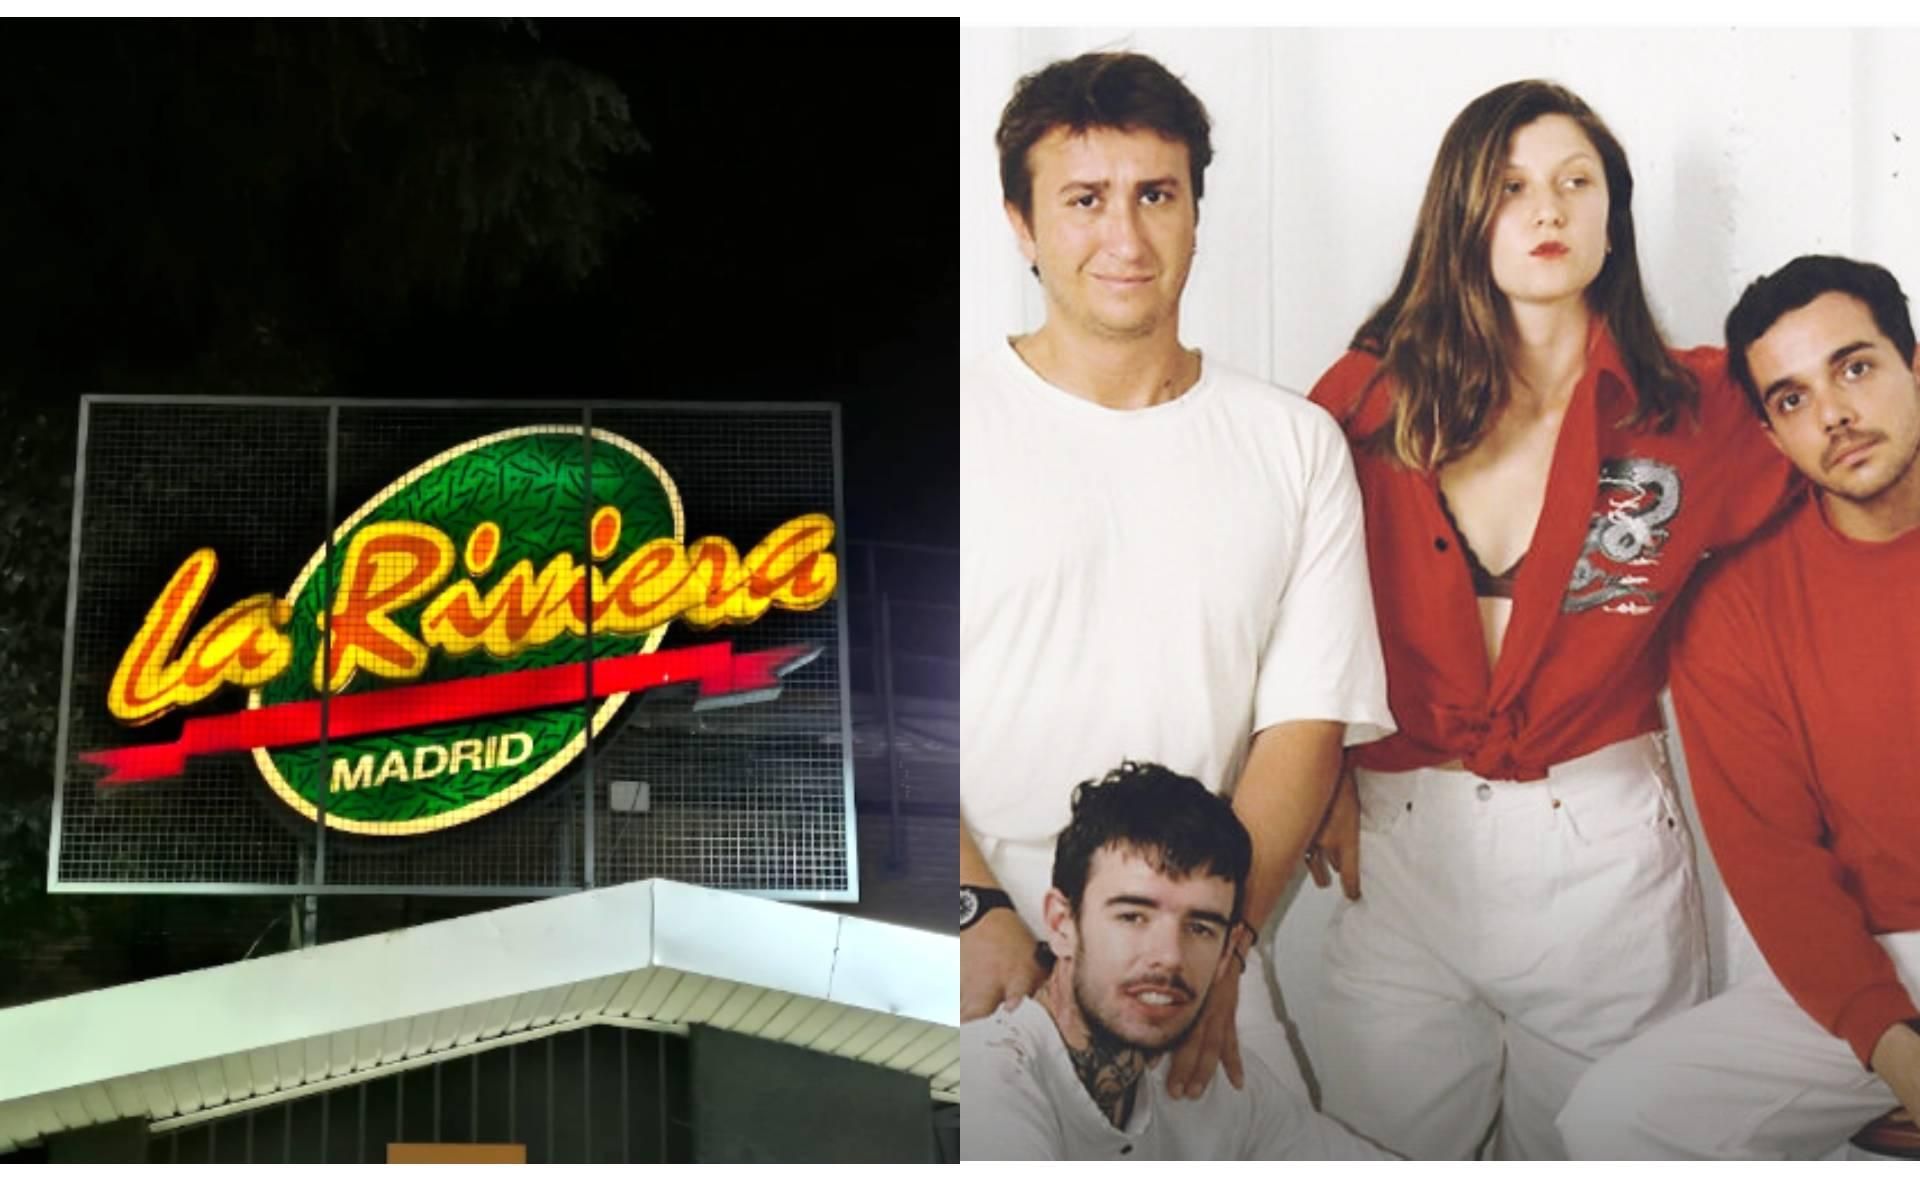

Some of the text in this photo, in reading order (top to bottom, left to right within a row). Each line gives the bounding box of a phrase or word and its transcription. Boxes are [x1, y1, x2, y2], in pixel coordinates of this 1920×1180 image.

[108, 506, 838, 725] La Riviera
[330, 731, 534, 793] MADRID
